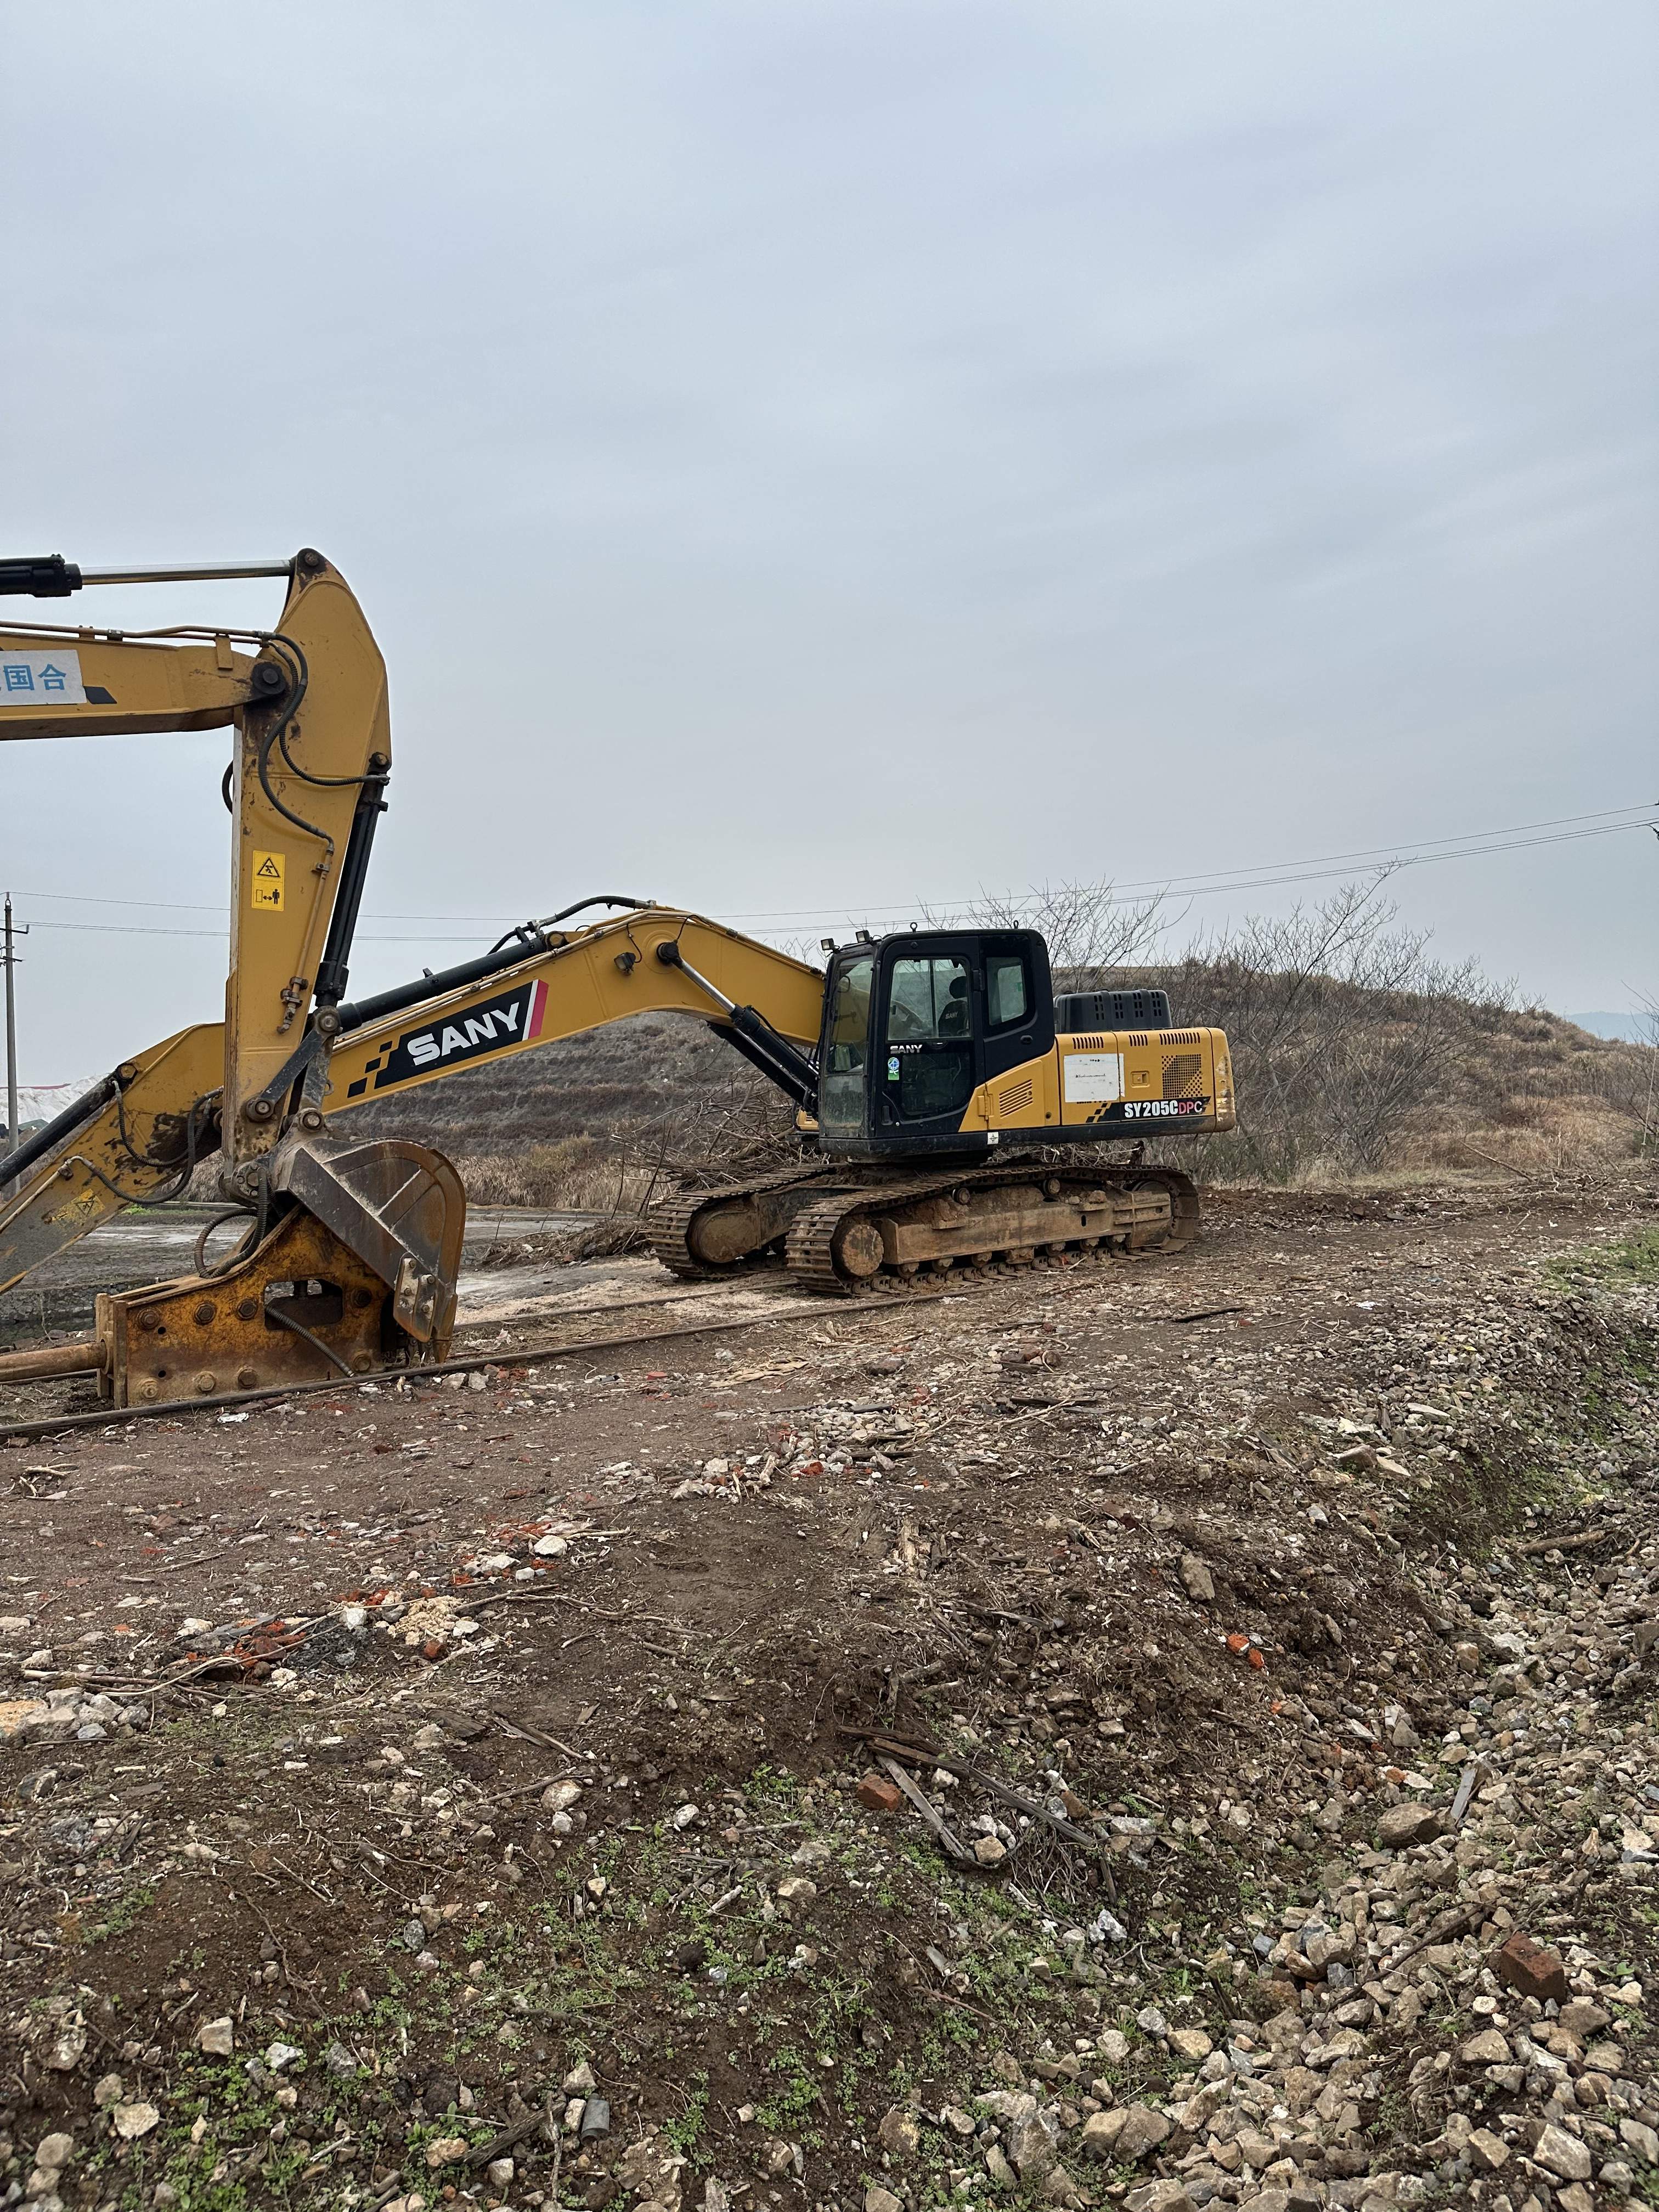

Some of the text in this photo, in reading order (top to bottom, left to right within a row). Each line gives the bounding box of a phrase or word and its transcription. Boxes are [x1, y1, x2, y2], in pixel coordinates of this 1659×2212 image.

[0, 663, 67, 691] 国合
[407, 1002, 520, 1066] SANY
[890, 1044, 923, 1054] SANY
